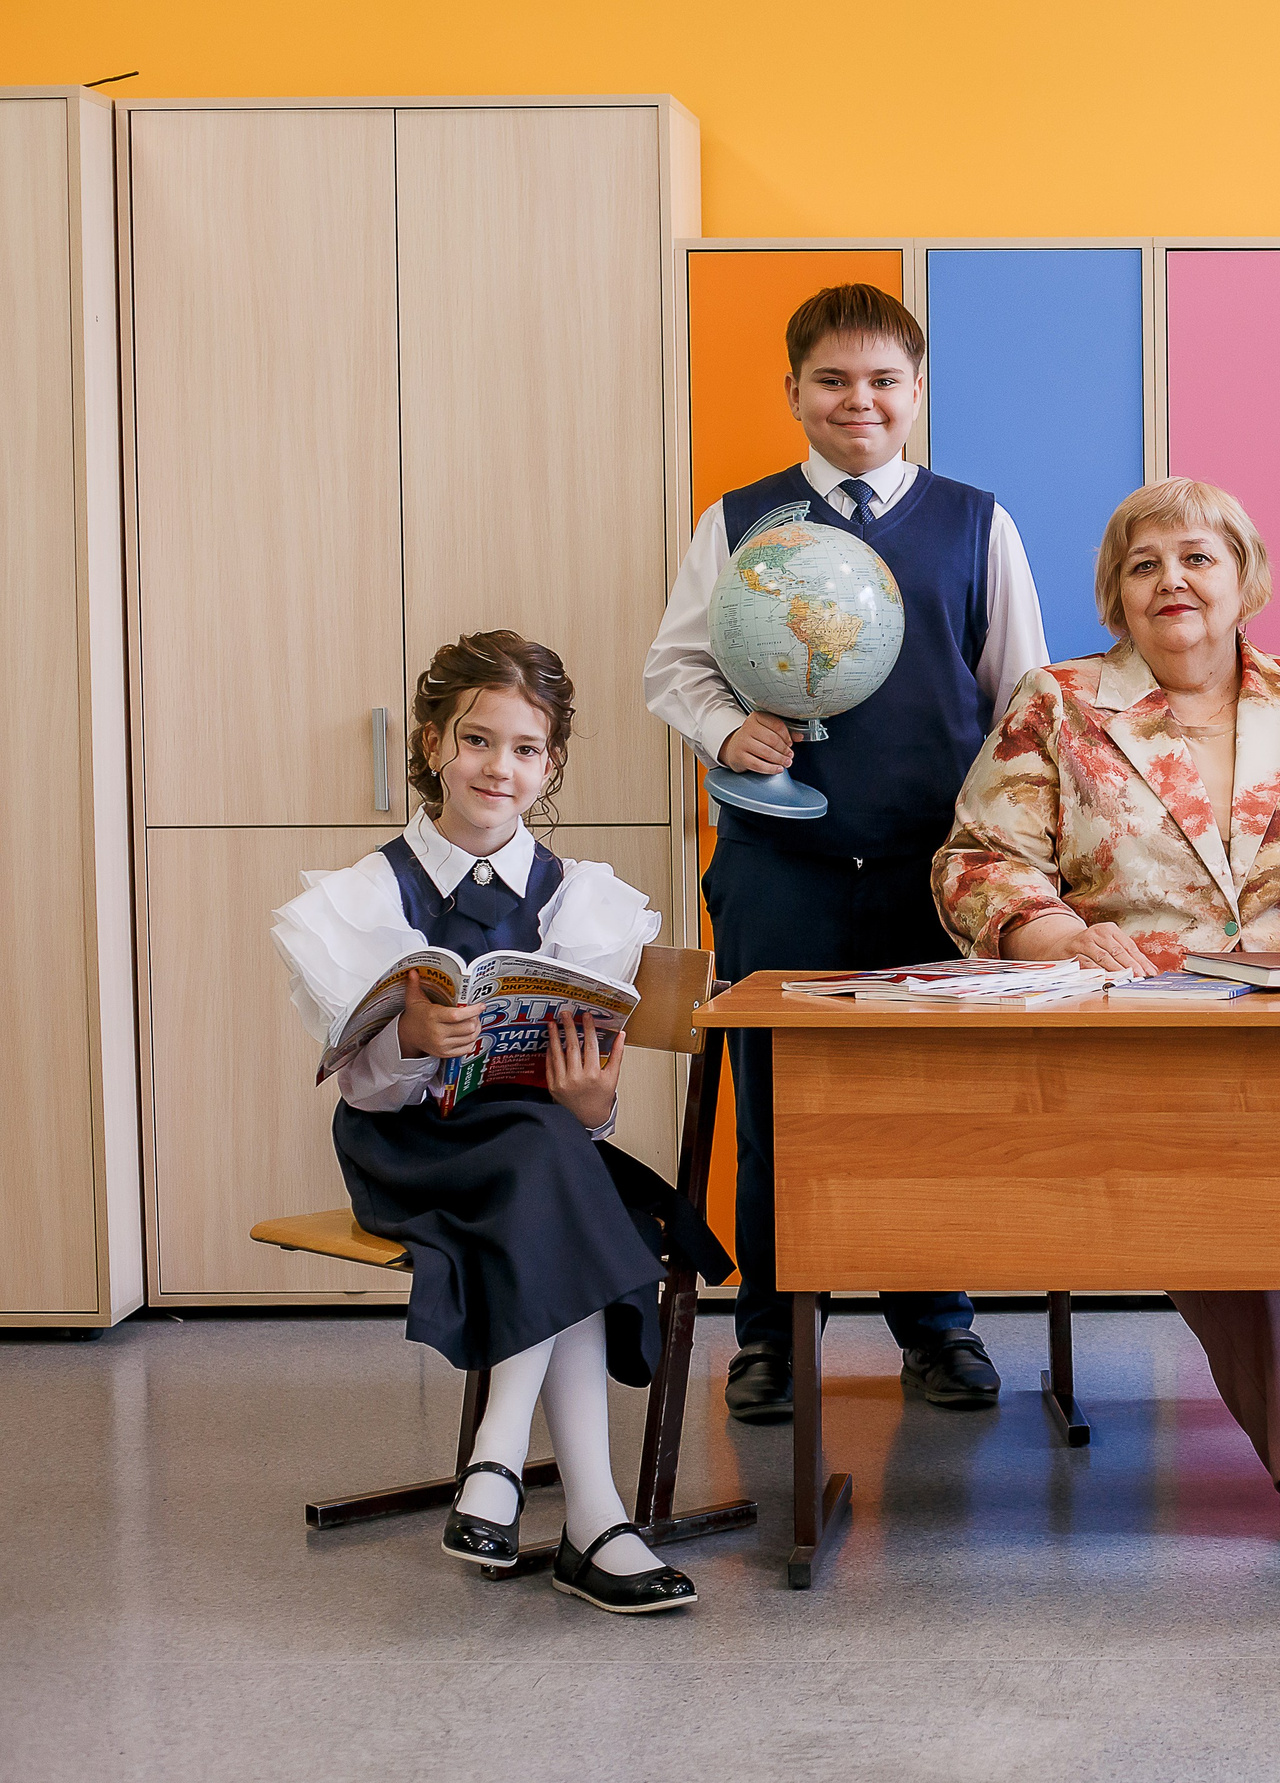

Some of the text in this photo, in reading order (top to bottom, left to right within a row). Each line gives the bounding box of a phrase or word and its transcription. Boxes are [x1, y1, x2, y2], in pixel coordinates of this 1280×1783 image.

[426, 969, 453, 987] МИР
[502, 976, 569, 989] ВАРИАНТОВ
[471, 982, 494, 1003] 25
[501, 984, 590, 1000] ОКРУЖАЮЩИЙ
[480, 995, 614, 1030] ВПР
[463, 1063, 475, 1091] класс
